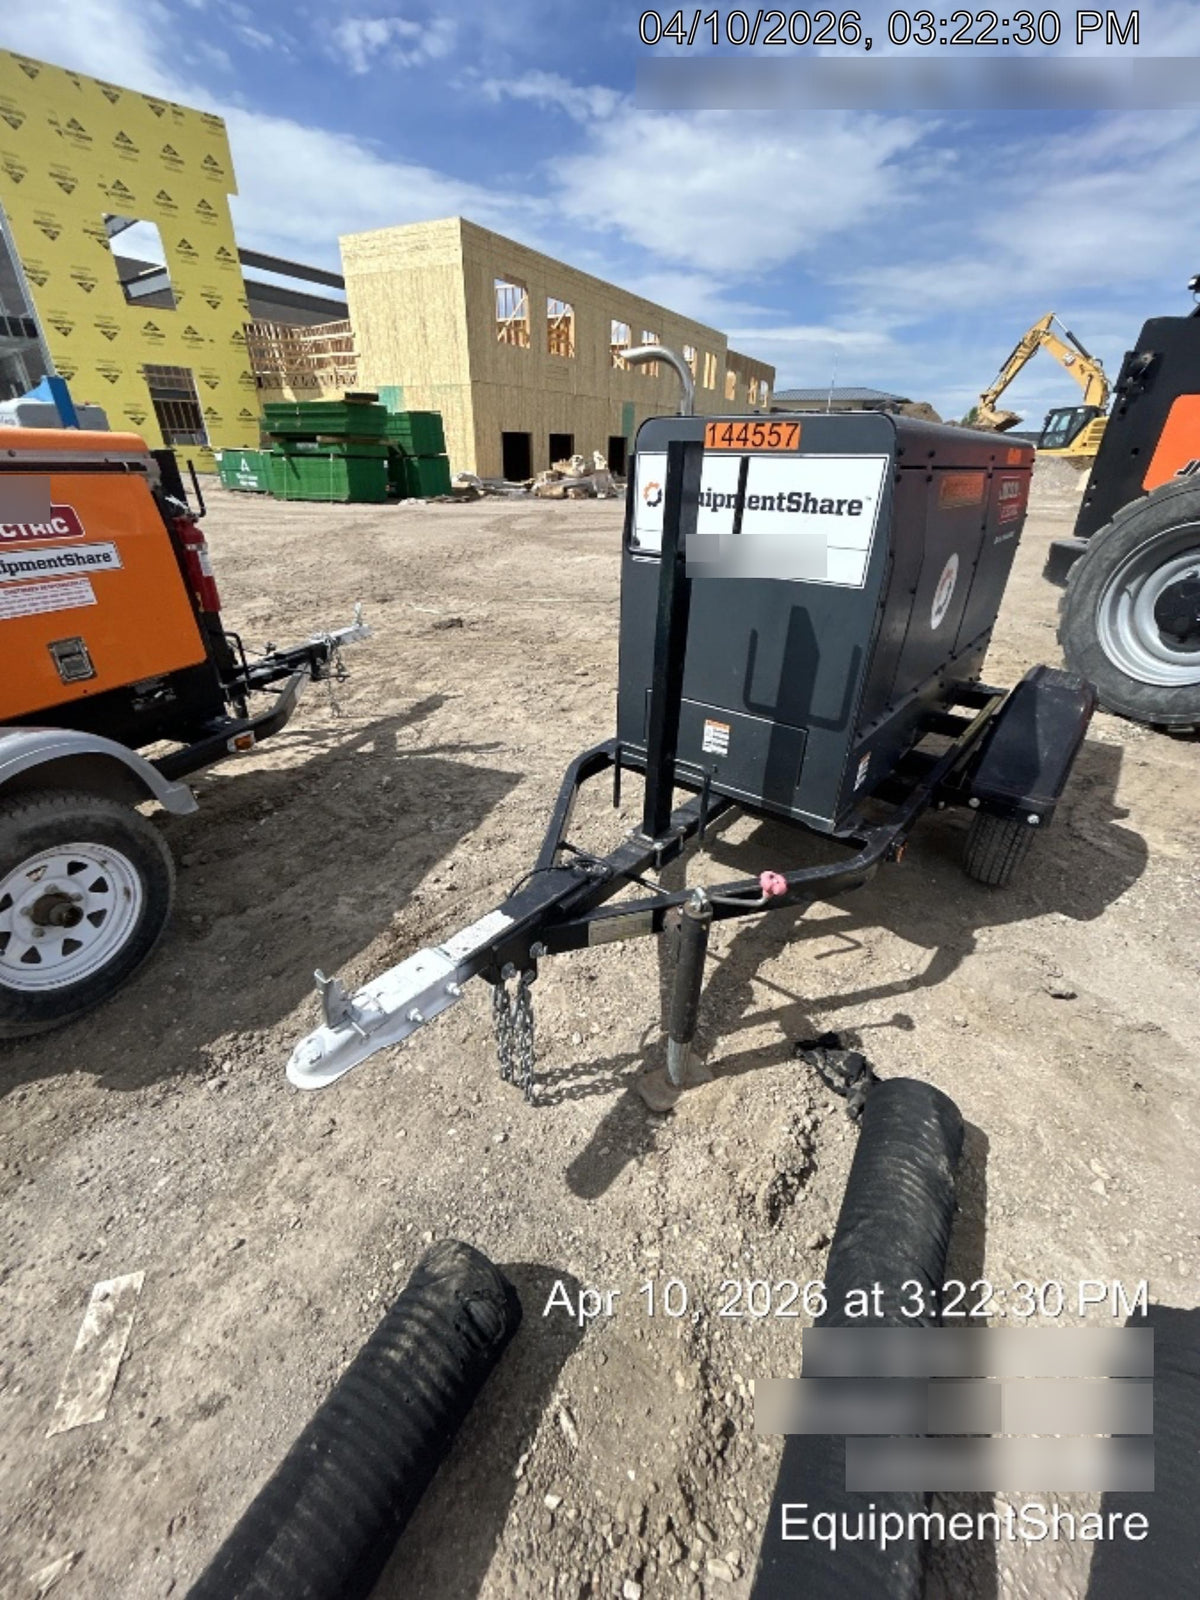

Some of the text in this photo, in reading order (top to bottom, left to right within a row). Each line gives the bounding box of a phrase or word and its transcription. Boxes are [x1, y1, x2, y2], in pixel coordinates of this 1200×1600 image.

[708, 422, 799, 447] 144557
[697, 486, 863, 517] uipmentShare
[0, 551, 112, 576] ipmentShare
